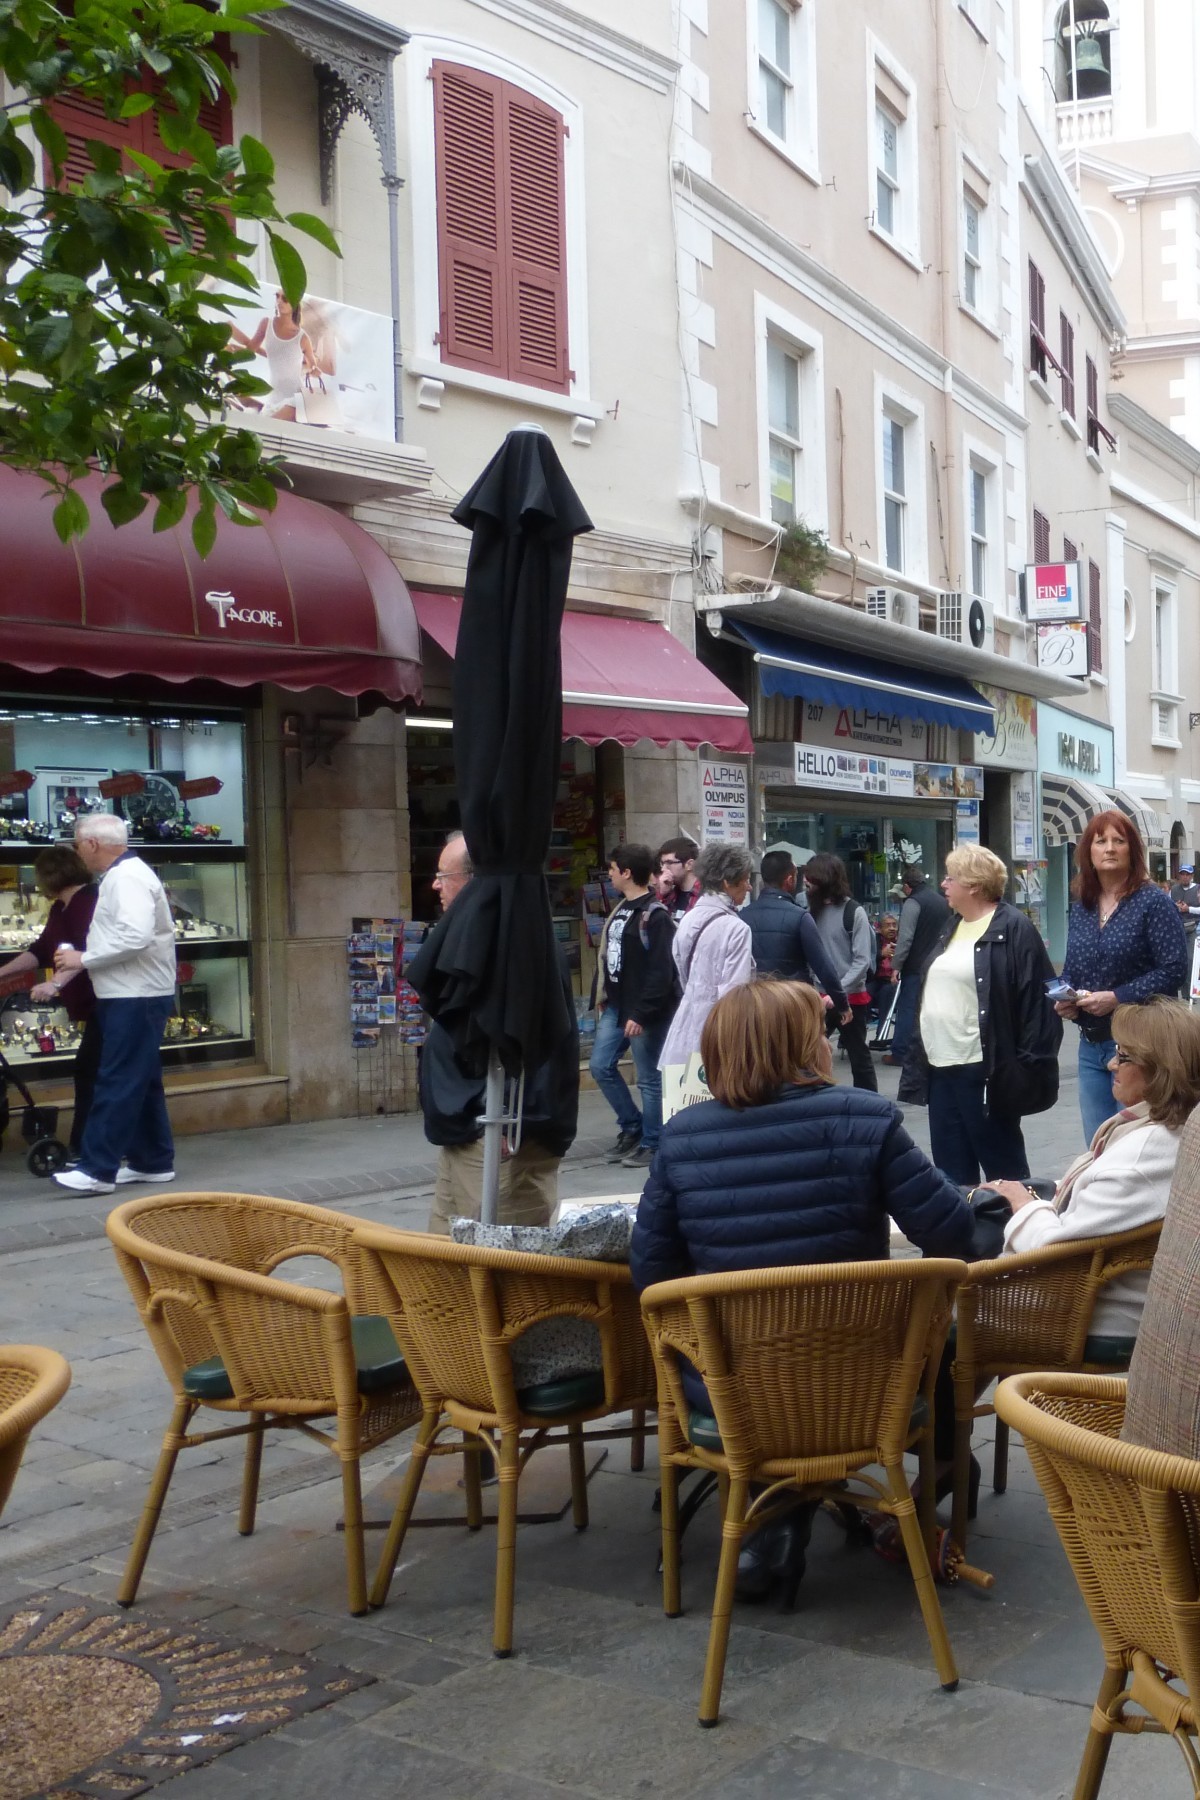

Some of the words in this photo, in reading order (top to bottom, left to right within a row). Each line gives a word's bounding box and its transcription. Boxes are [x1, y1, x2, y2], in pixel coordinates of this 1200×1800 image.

[1037, 585, 1067, 599] FINE
[205, 591, 277, 628] TAGORE
[1041, 633, 1075, 667] B
[808, 704, 823, 721] 207
[911, 724, 923, 739] 207
[797, 751, 836, 777] HELLO
[703, 767, 745, 786] ALPHA
[889, 768, 912, 779] OLYMPUS
[705, 790, 745, 804] OLYMPUS
